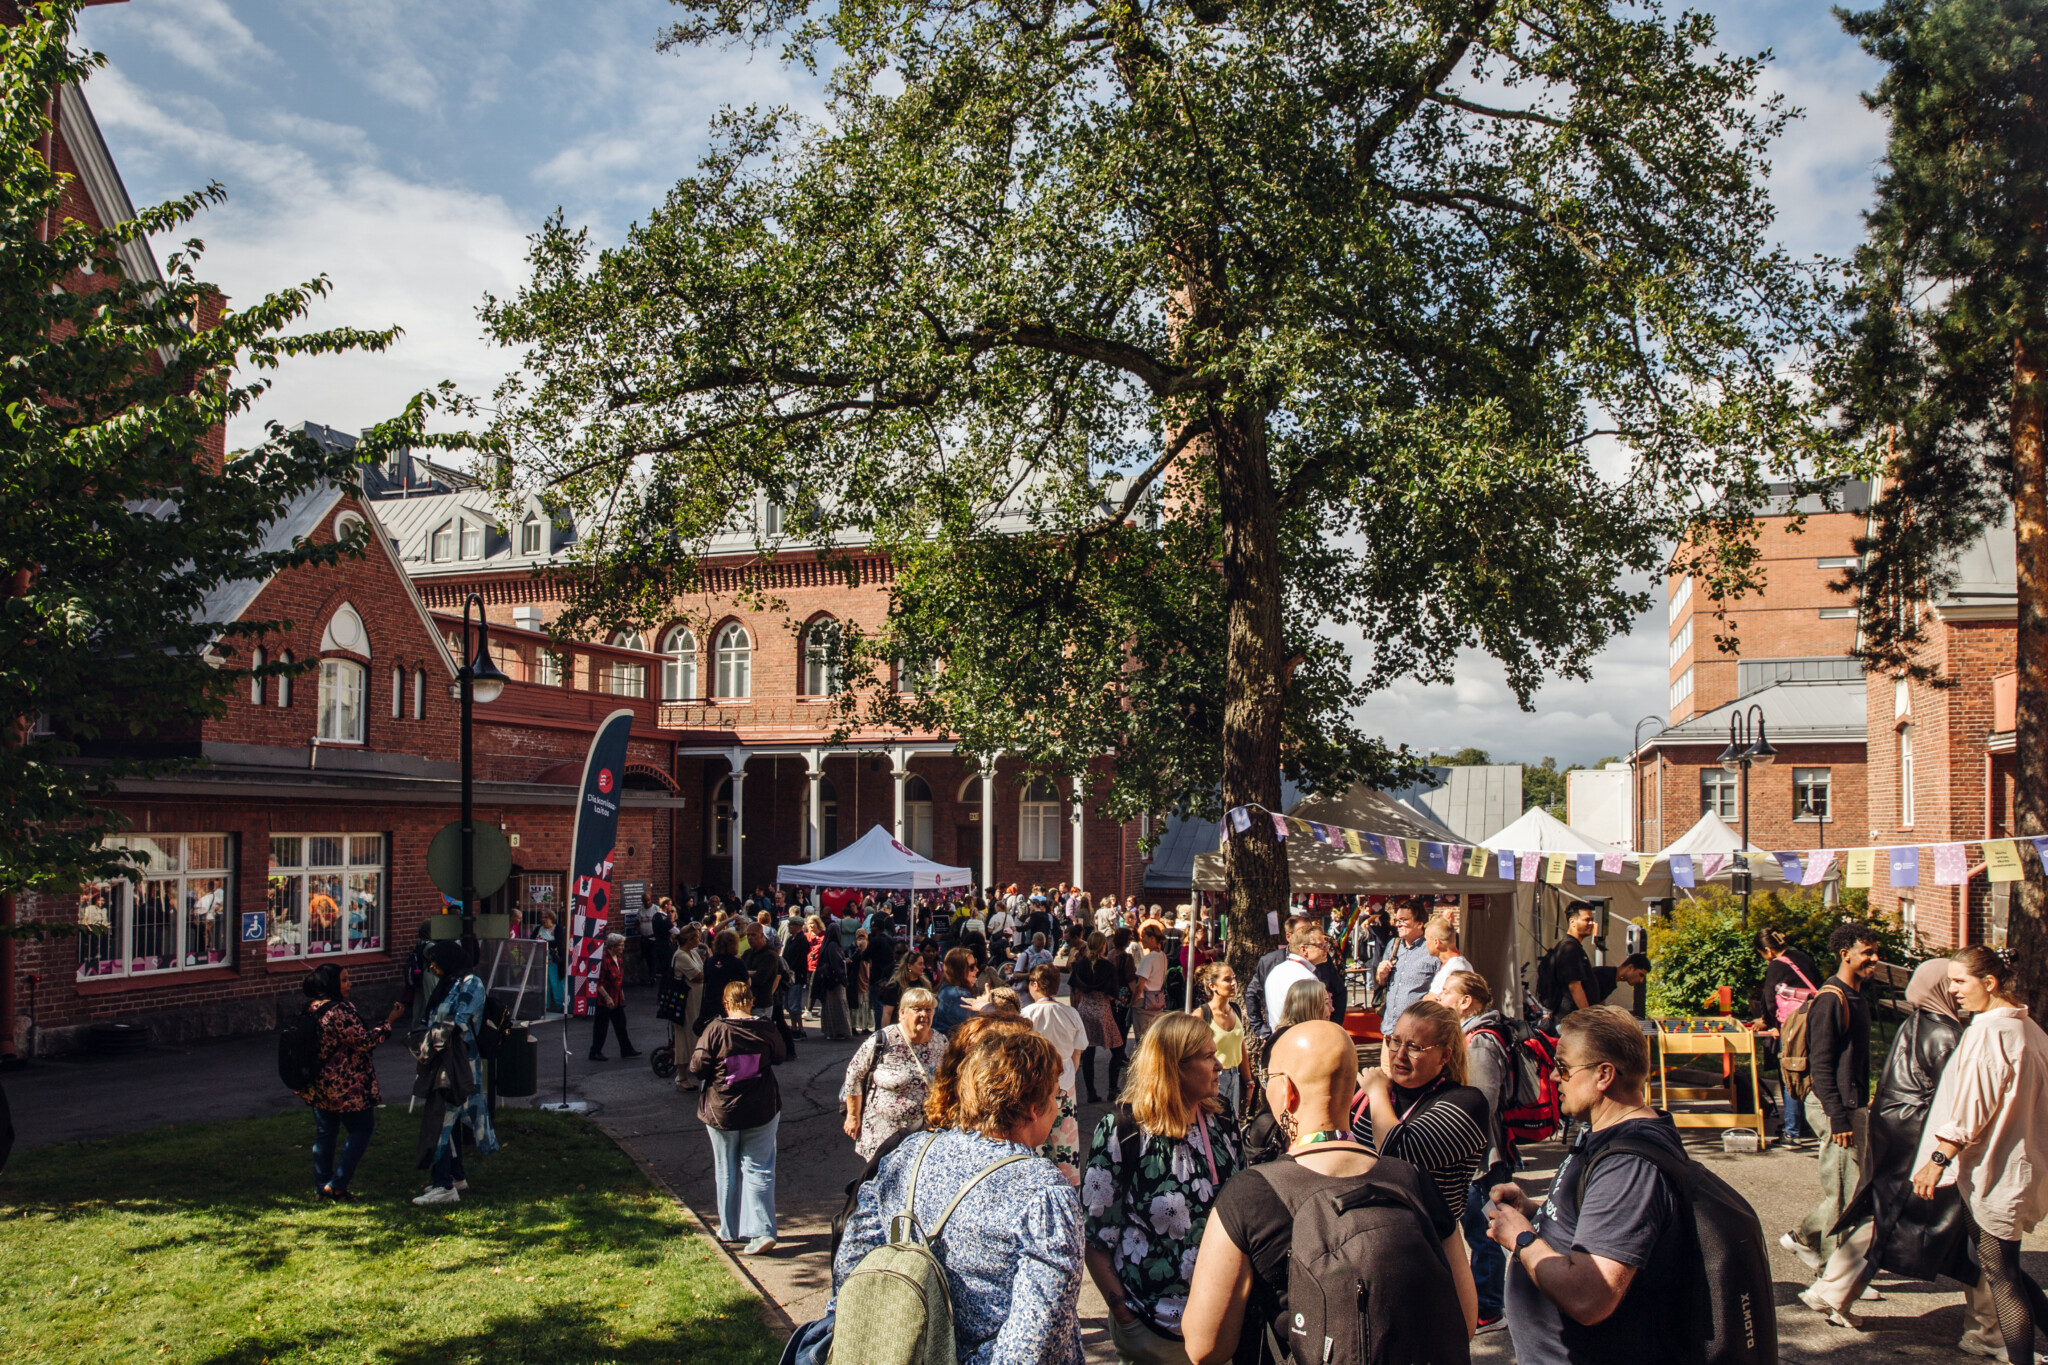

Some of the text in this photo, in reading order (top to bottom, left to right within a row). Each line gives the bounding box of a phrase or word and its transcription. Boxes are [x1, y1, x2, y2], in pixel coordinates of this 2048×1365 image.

[594, 804, 610, 817] laitos
[513, 837, 518, 845] 3
[1740, 1292, 1755, 1349] XLMOTO
